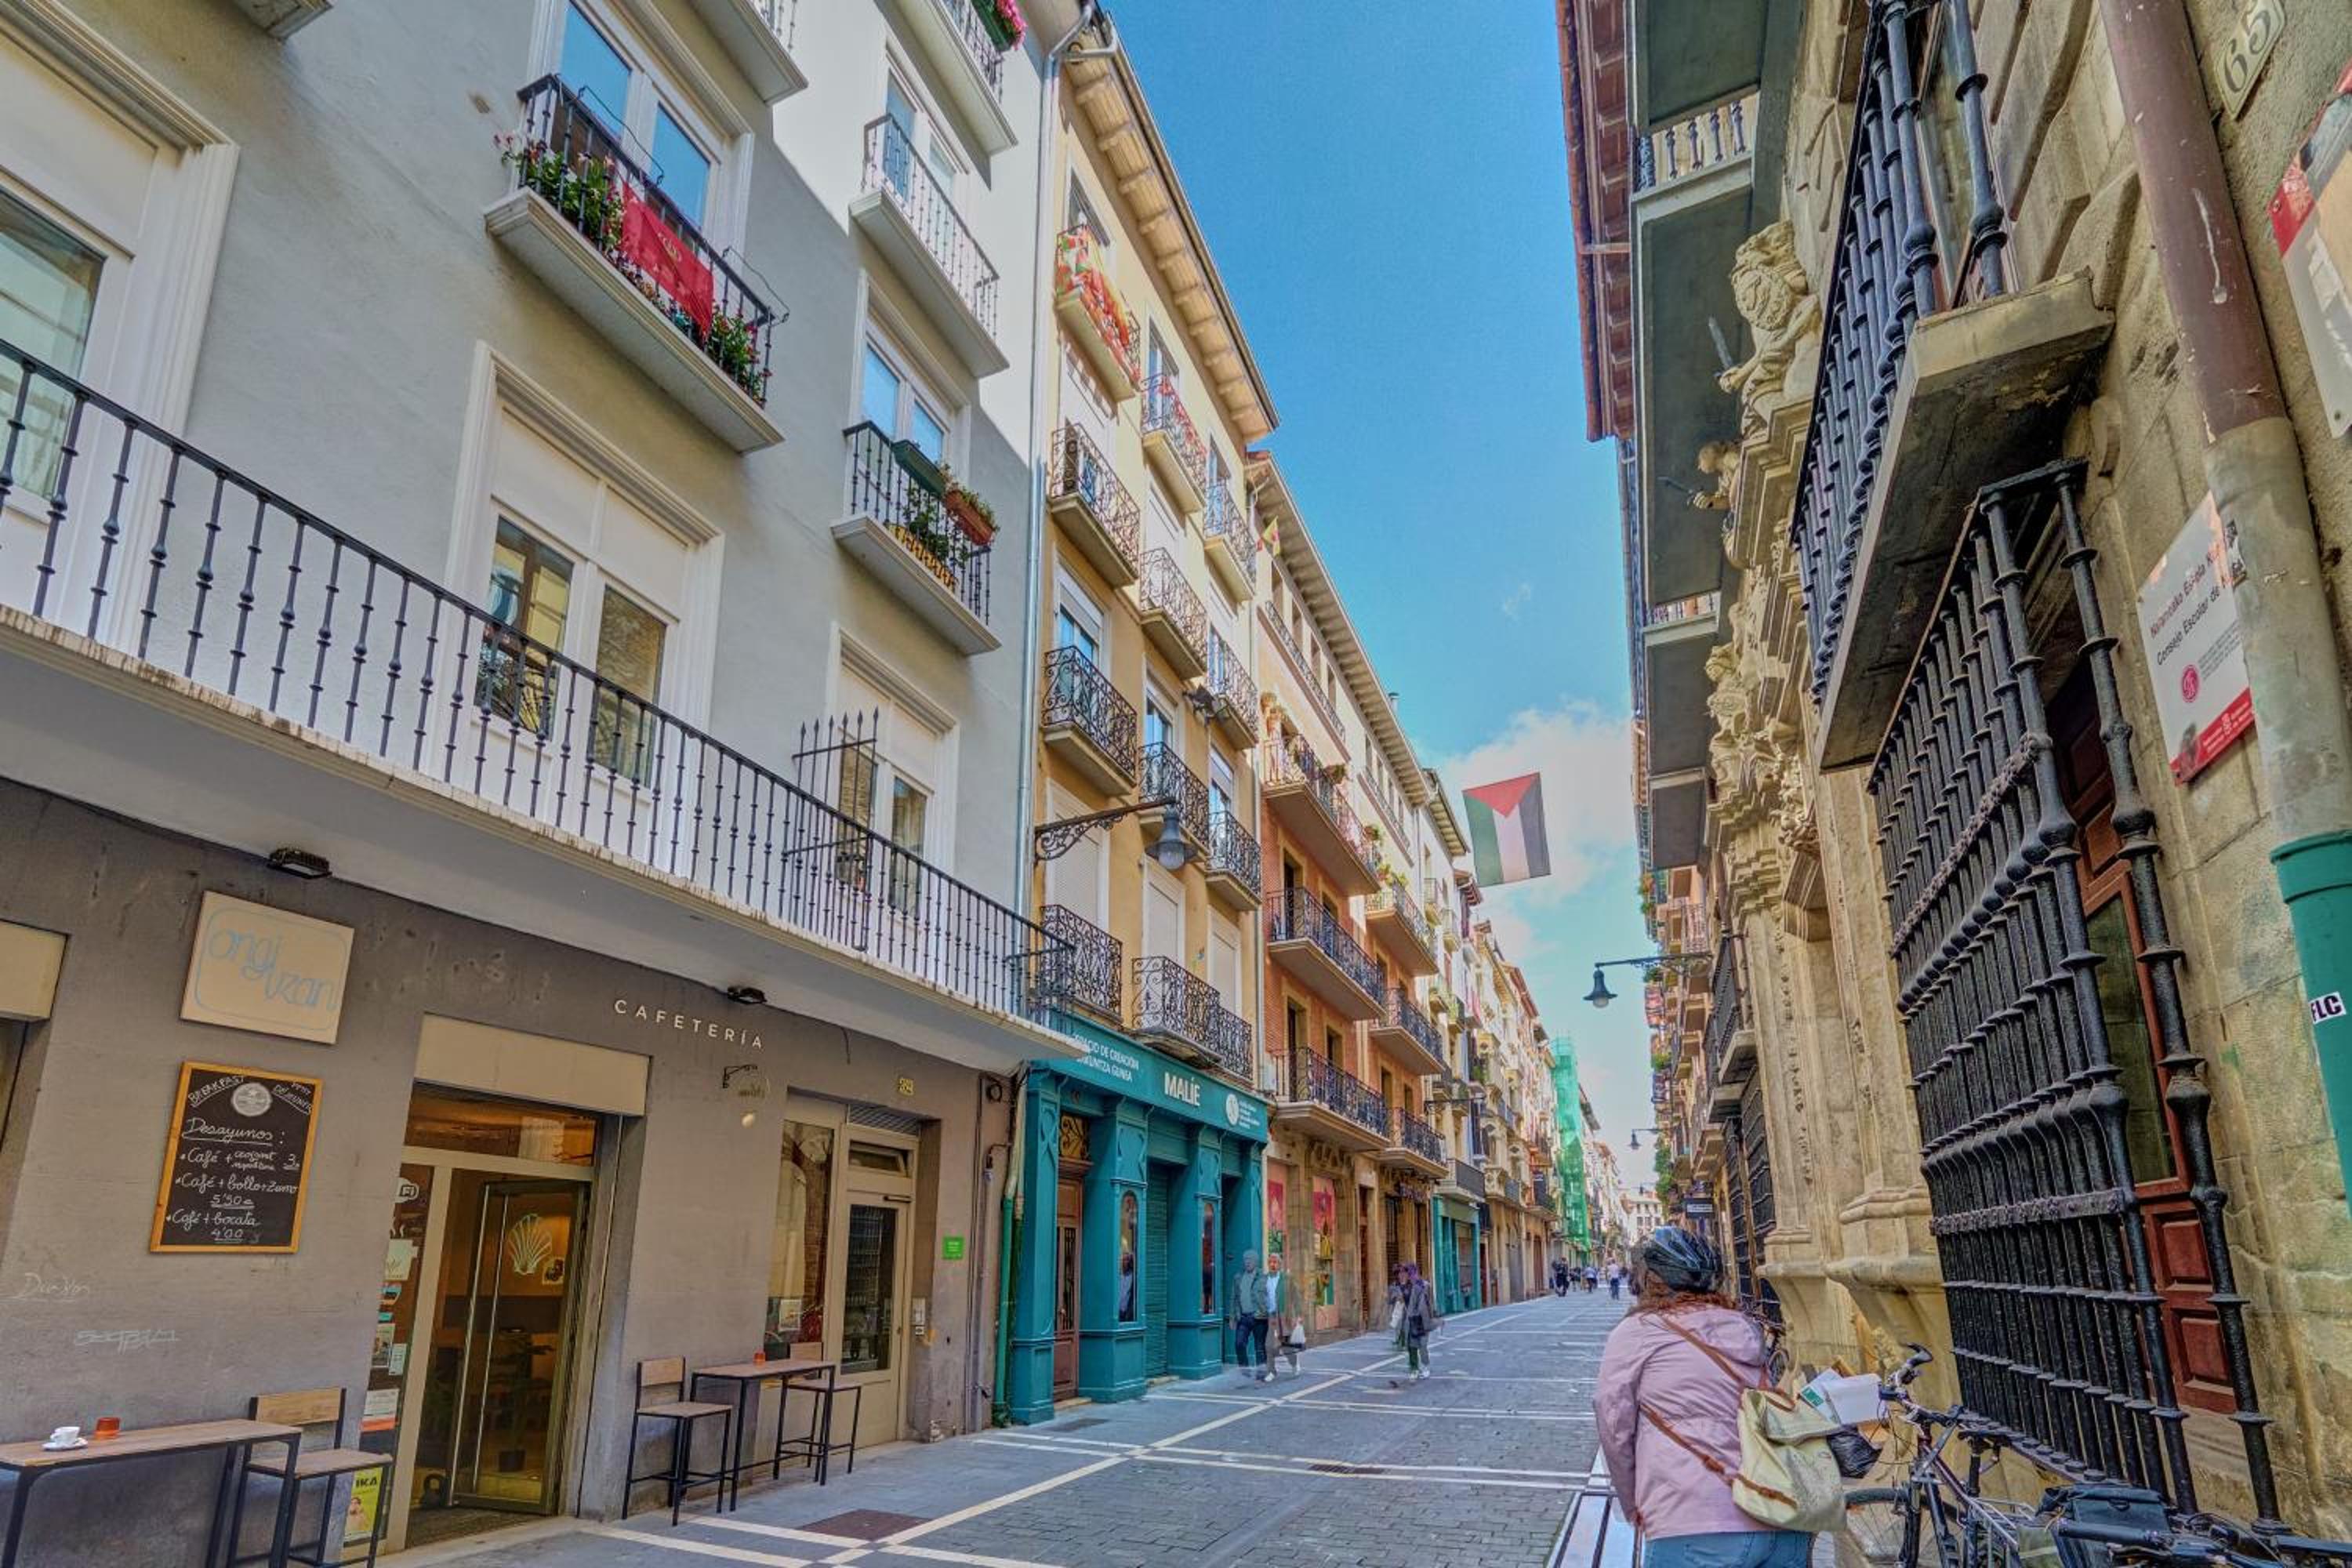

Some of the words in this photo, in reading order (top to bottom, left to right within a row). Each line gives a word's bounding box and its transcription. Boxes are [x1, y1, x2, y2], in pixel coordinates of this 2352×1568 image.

[2225, 9, 2271, 93] 65
[2157, 630, 2183, 666] Consejo
[2183, 596, 2209, 635] Escolar
[615, 1000, 762, 1049] CAFETERÍA
[187, 1147, 218, 1168] Café
[181, 1173, 215, 1193] Café
[172, 1209, 199, 1231] Café
